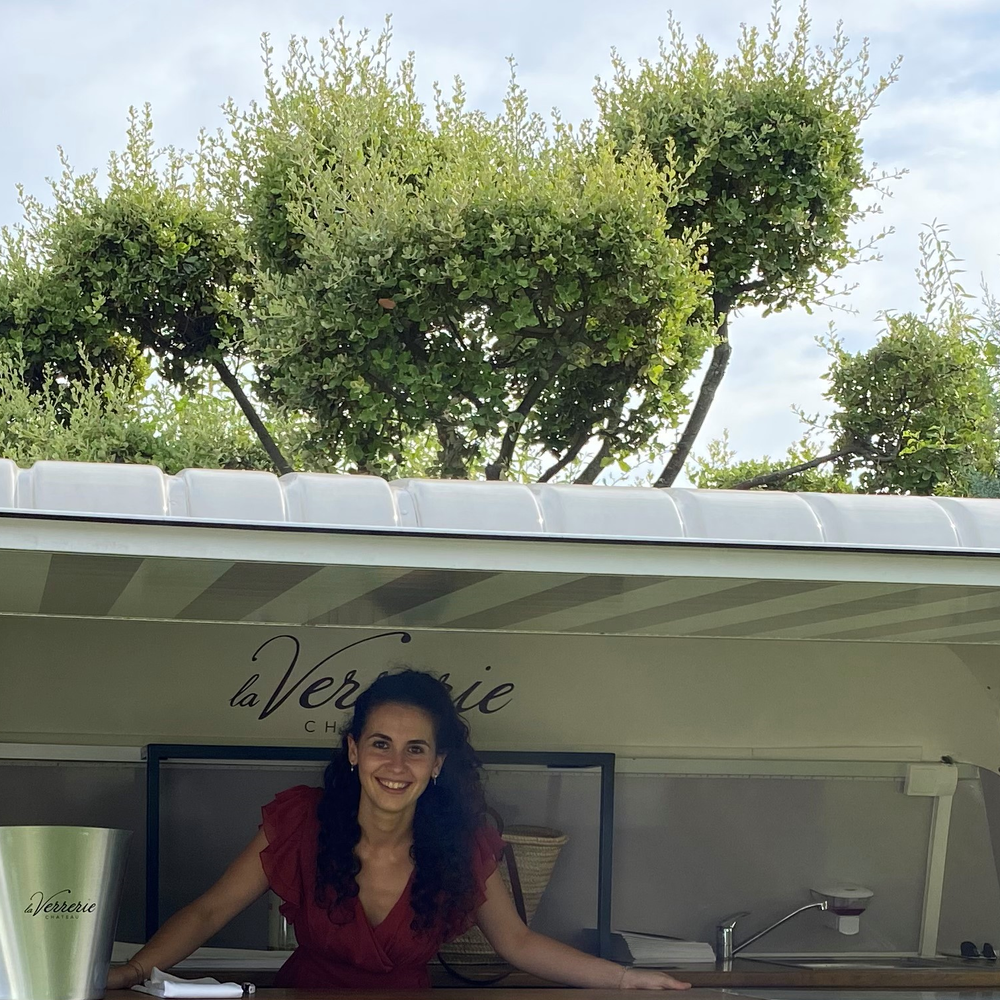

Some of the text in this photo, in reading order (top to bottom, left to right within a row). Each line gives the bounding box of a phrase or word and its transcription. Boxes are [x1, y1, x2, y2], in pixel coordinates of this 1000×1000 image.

[229, 631, 516, 721] la Verie
[29, 888, 97, 917] Verrerie
